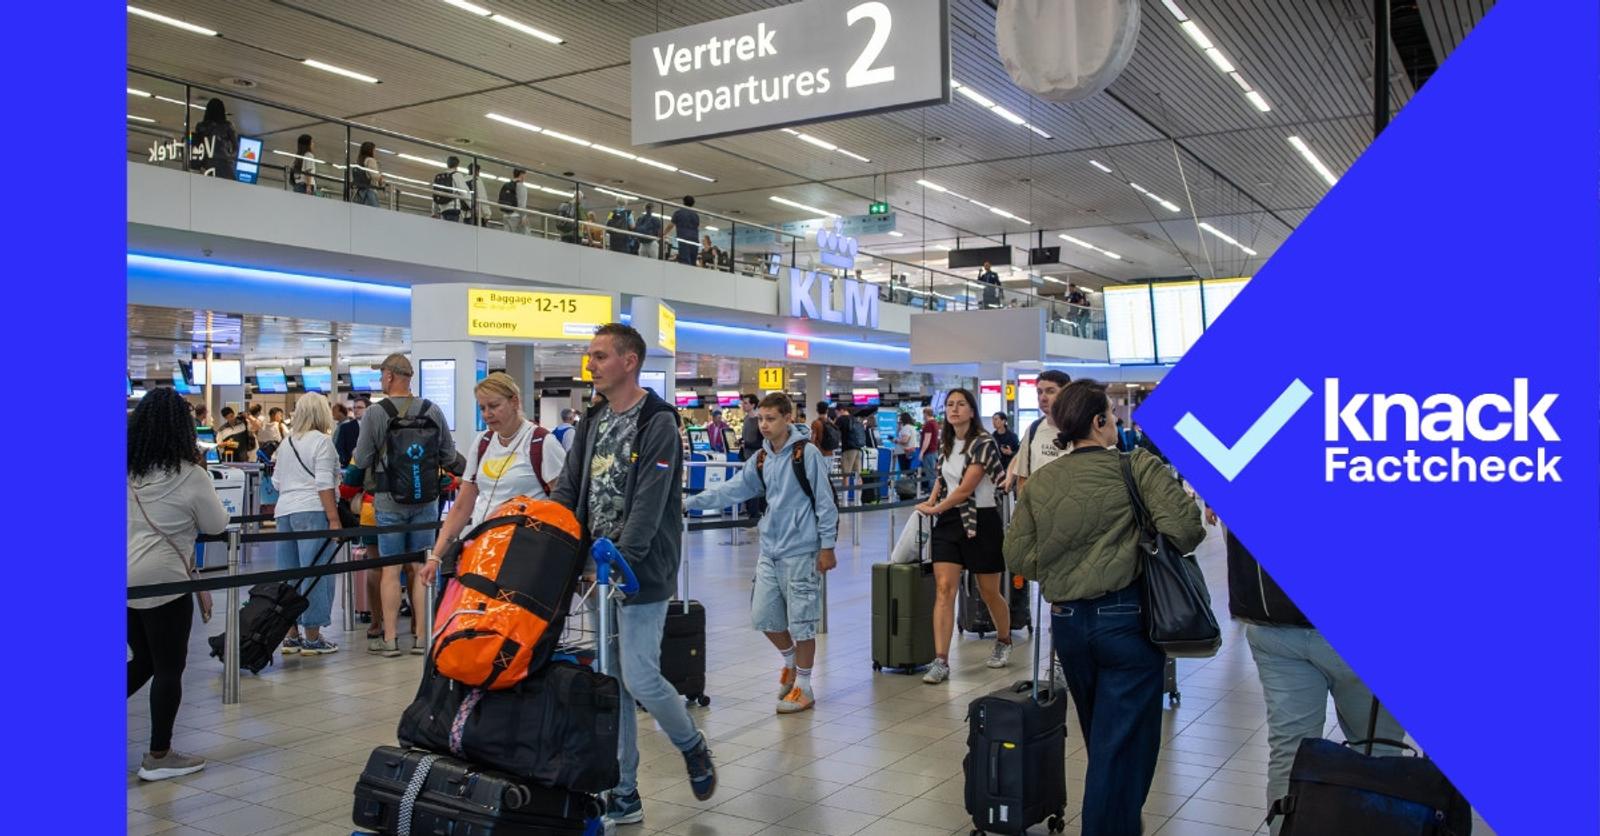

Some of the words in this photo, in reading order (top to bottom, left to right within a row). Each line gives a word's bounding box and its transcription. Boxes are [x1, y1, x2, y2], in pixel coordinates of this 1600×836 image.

[652, 22, 778, 77] Vertrek
[845, 1, 895, 88] 2
[654, 67, 831, 122] Departures
[472, 319, 517, 331] Economy
[490, 293, 533, 305] Baggage
[535, 298, 577, 313] 12-15
[790, 267, 880, 329] KLM
[764, 370, 778, 383] 11
